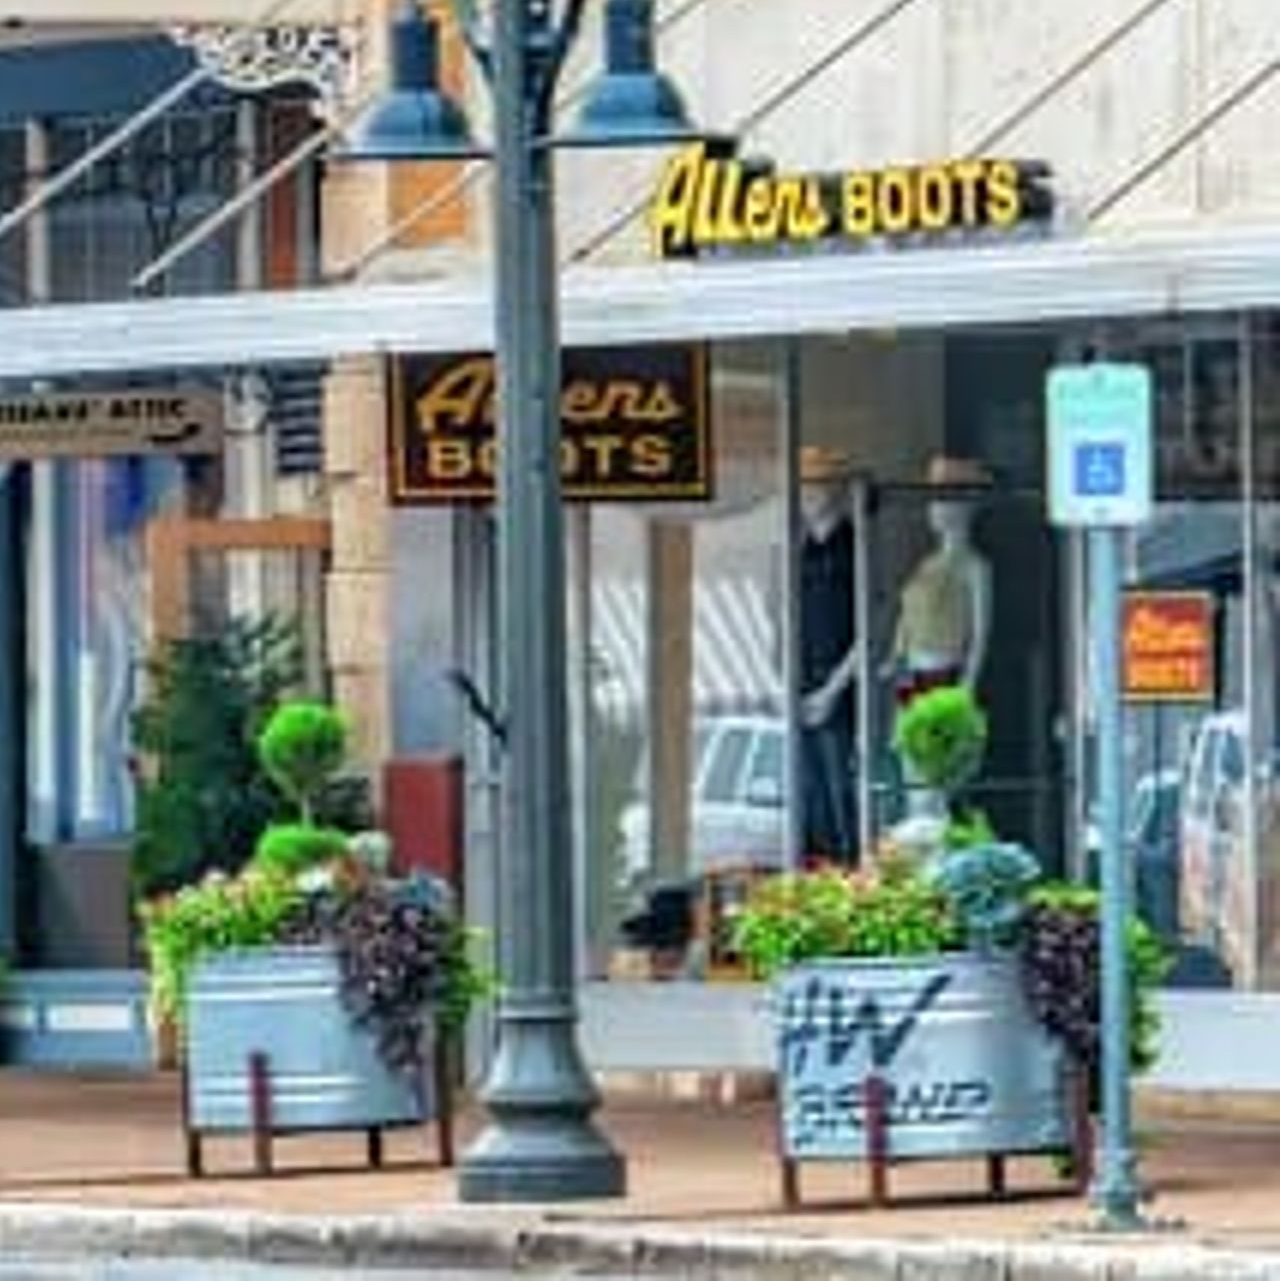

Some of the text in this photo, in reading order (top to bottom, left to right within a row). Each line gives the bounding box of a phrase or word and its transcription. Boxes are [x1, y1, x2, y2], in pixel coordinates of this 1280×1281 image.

[650, 140, 1020, 257] Allens BOOTS
[415, 356, 683, 431] Aens
